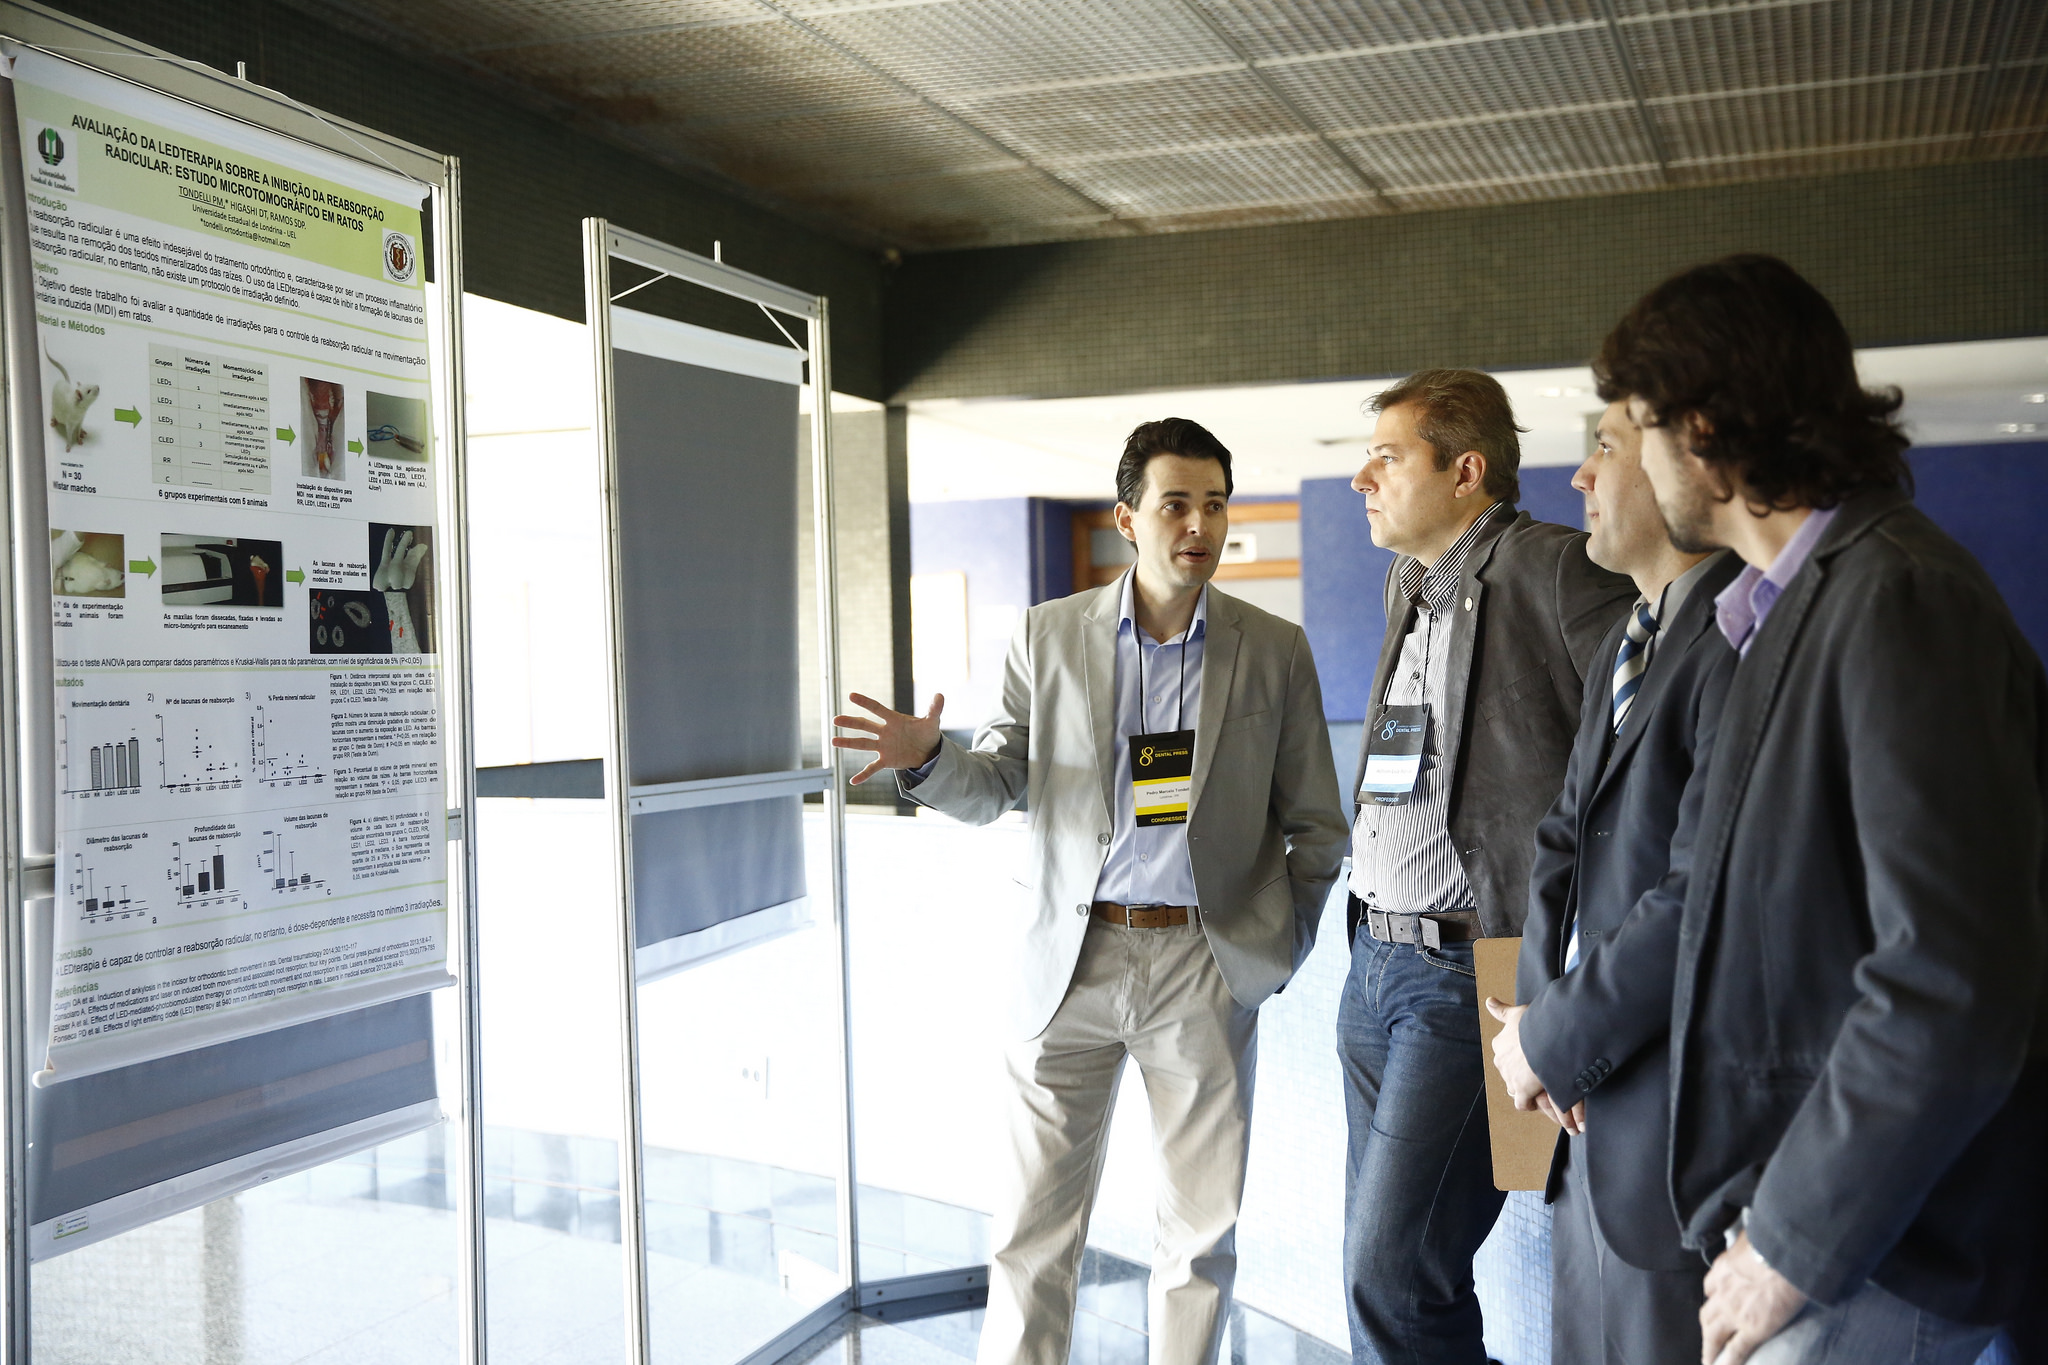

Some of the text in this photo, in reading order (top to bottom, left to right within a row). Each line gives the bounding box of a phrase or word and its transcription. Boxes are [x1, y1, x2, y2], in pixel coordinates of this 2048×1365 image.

[71, 114, 384, 222] AVALIAÇÃO DA LEDTERAPIA SOBRE A INIBIÇÃO DA REABSORÇÃO
[105, 143, 364, 232] RADICULAR: ESTUDO MICROTOMOGRÁFICO EM RATOS
[27, 192, 67, 211] ntrodução
[178, 185, 212, 206] TONDELLI
[230, 200, 257, 216] HIGASHI
[258, 208, 268, 220] DT,
[269, 211, 293, 226] RAMOS
[293, 218, 306, 230] SDP.
[192, 204, 227, 220] Universidade
[228, 213, 250, 226] Estadual
[251, 220, 258, 229] de
[259, 222, 282, 235] Londrina
[286, 230, 296, 239] UEL
[33, 209, 75, 228] reabsorção
[78, 221, 113, 236] radicular
[115, 228, 120, 238] é
[123, 233, 139, 243] uma
[141, 236, 161, 248] efeito
[163, 243, 202, 258] indesejável
[203, 251, 212, 261] do
[214, 254, 248, 270] tratamento
[250, 264, 286, 279] ortodôntico
[287, 273, 293, 282] e,
[295, 275, 333, 291] caracteriza-se
[334, 285, 344, 294] por
[345, 288, 354, 296] ser
[365, 293, 388, 306] processo
[389, 299, 423, 313] inflamatório
[68, 249, 300, 308] radicular, no entanto, não existe um protocolo de irradiação definido.
[58, 297, 91, 311] induzida
[94, 303, 116, 318] (MDI)
[118, 309, 130, 318] em
[132, 312, 154, 324] ratos.
[60, 320, 66, 328] e
[68, 319, 105, 335] Métodos
[69, 284, 92, 297] deste
[95, 289, 127, 304] trabalho
[130, 295, 139, 306] foi
[142, 299, 166, 311] avaliar
[175, 307, 213, 322] quantidade
[215, 314, 224, 324] de
[226, 318, 261, 332] irradiações
[263, 325, 278, 335] para
[286, 330, 310, 342] controle
[311, 334, 319, 344] da
[320, 337, 350, 351] reabsorção
[351, 344, 373, 355] radicular
[382, 352, 426, 366] movimentação
[154, 358, 172, 366] Grupos
[157, 396, 172, 404] LED2
[158, 415, 173, 425] LED3
[158, 435, 174, 444] CLED
[62, 470, 67, 478] N
[73, 471, 82, 480] 30
[70, 484, 96, 493] machos
[158, 489, 163, 497] 6
[164, 491, 186, 500] grupos
[187, 493, 228, 503] experimentais
[246, 498, 268, 507] animais
[194, 824, 226, 833] Profundidade
[215, 830, 241, 839] reabsorção
[86, 836, 110, 844] Diâmetro
[60, 959, 100, 976] LEDterapia
[101, 959, 107, 968] é
[109, 955, 132, 967] capaz
[133, 952, 143, 962] de
[144, 947, 175, 960] controlar
[176, 946, 182, 954] a
[183, 937, 224, 952] reabsorção
[225, 933, 253, 945] radicular,
[262, 927, 286, 938] entanto,
[287, 923, 292, 933] é
[293, 916, 345, 932] dose-dependente
[350, 910, 376, 921] necessita
[384, 905, 404, 914] mínimo
[404, 903, 408, 911] 3
[409, 898, 442, 910] irradiações.
[55, 982, 99, 998] Referências
